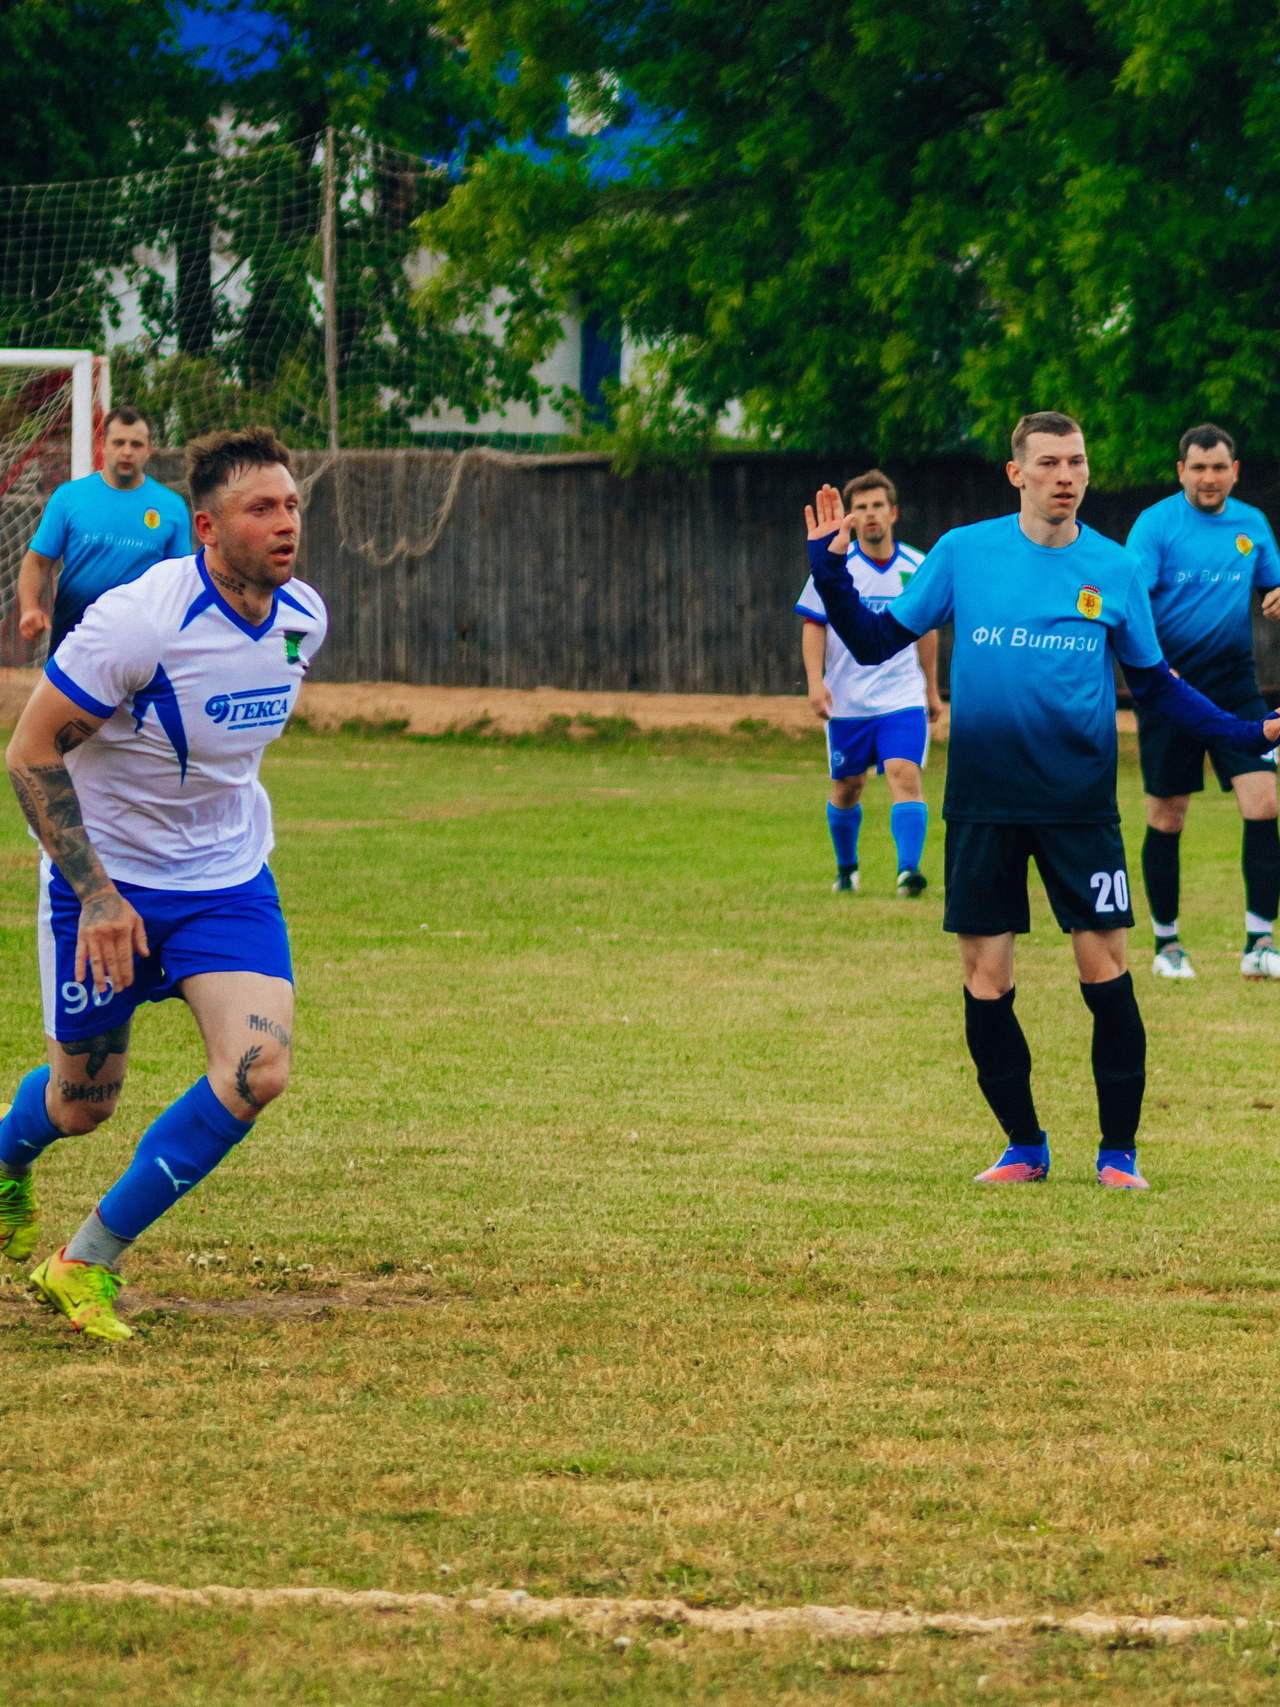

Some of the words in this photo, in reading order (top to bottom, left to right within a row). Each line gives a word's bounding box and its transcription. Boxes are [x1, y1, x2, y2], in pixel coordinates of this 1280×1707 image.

[972, 626, 1006, 645] ФК
[1010, 627, 1098, 652] Витязи
[228, 698, 288, 722] ГЕКСА
[1090, 869, 1129, 913] 20
